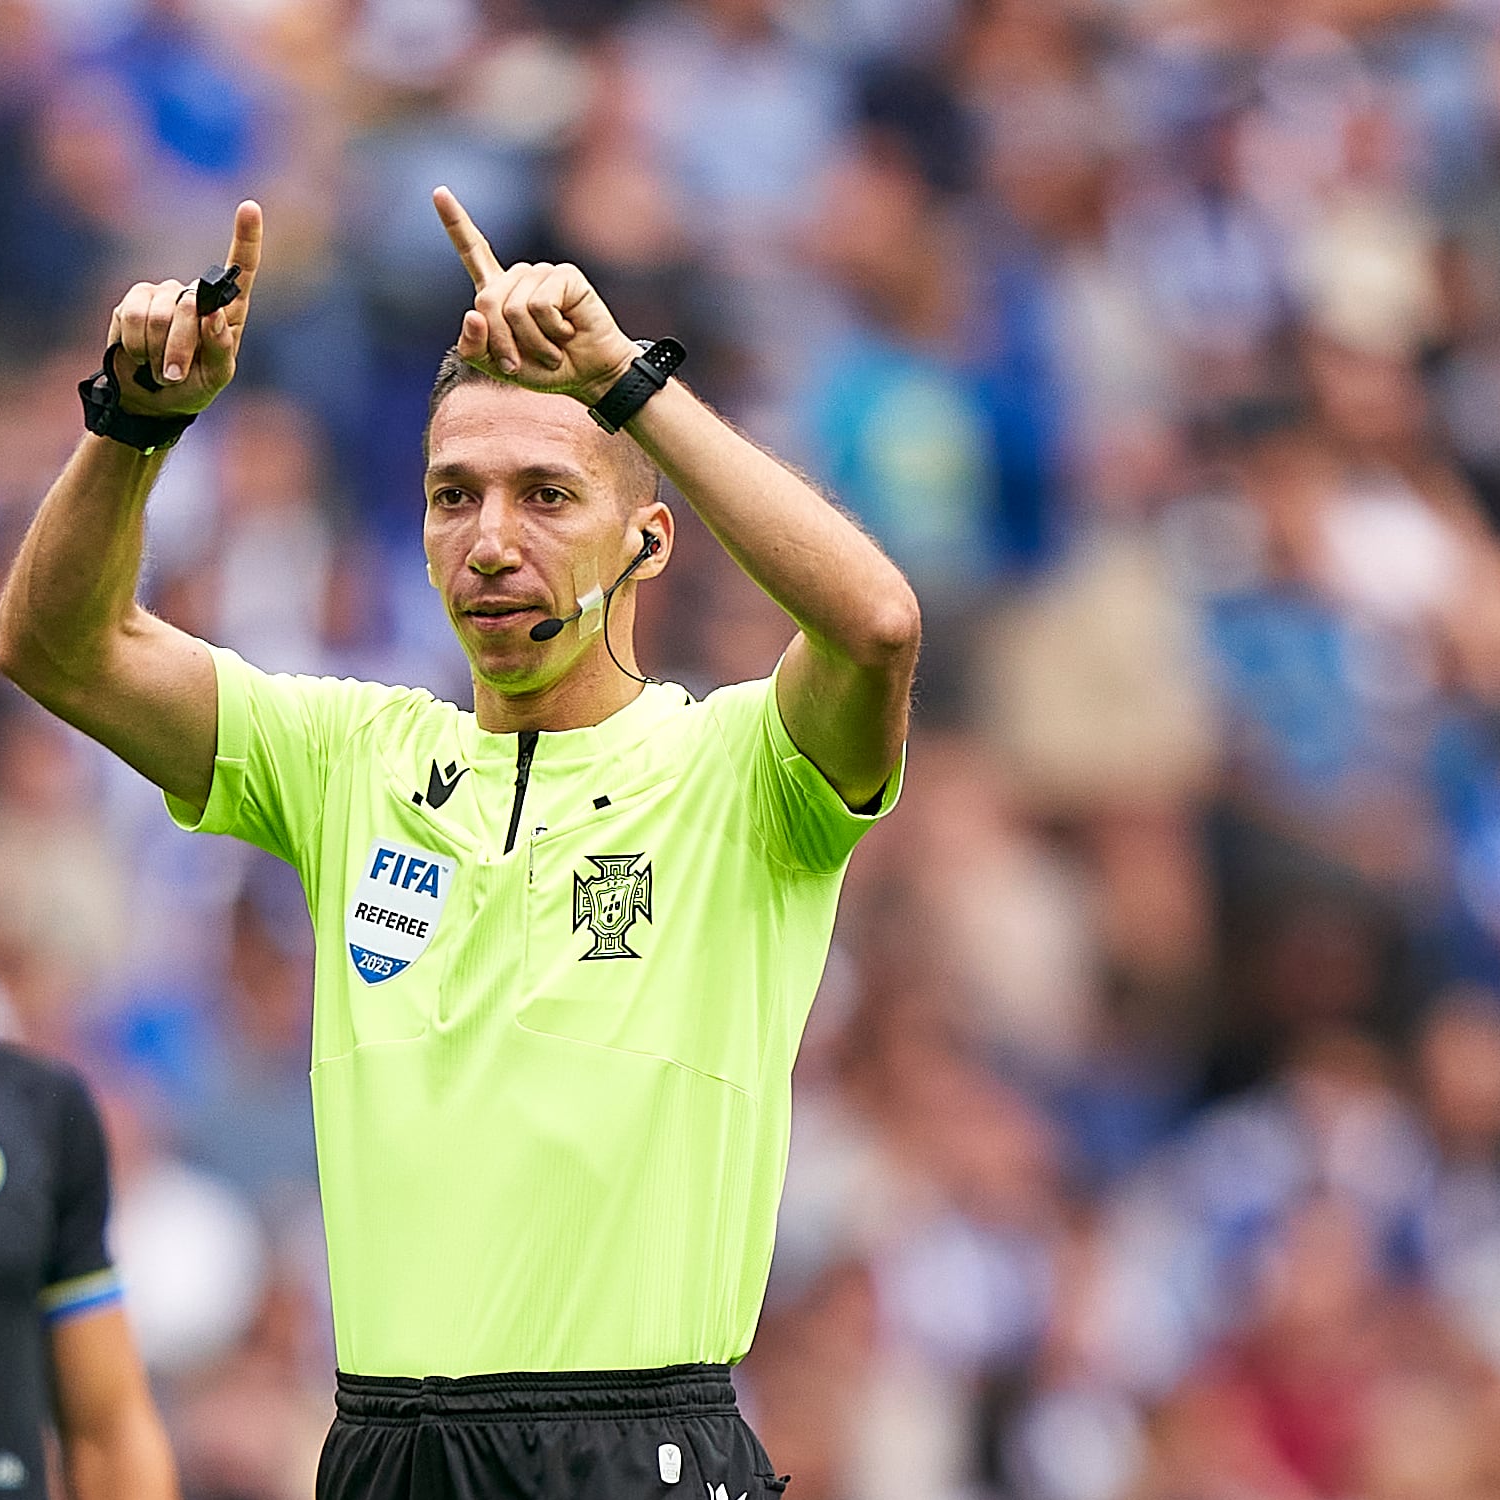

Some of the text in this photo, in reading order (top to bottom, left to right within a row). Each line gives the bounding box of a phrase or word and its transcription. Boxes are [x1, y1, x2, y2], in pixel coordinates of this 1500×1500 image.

[370, 848, 440, 898] FIFA
[354, 902, 430, 939] REFEREE
[358, 953, 394, 976] 2023
